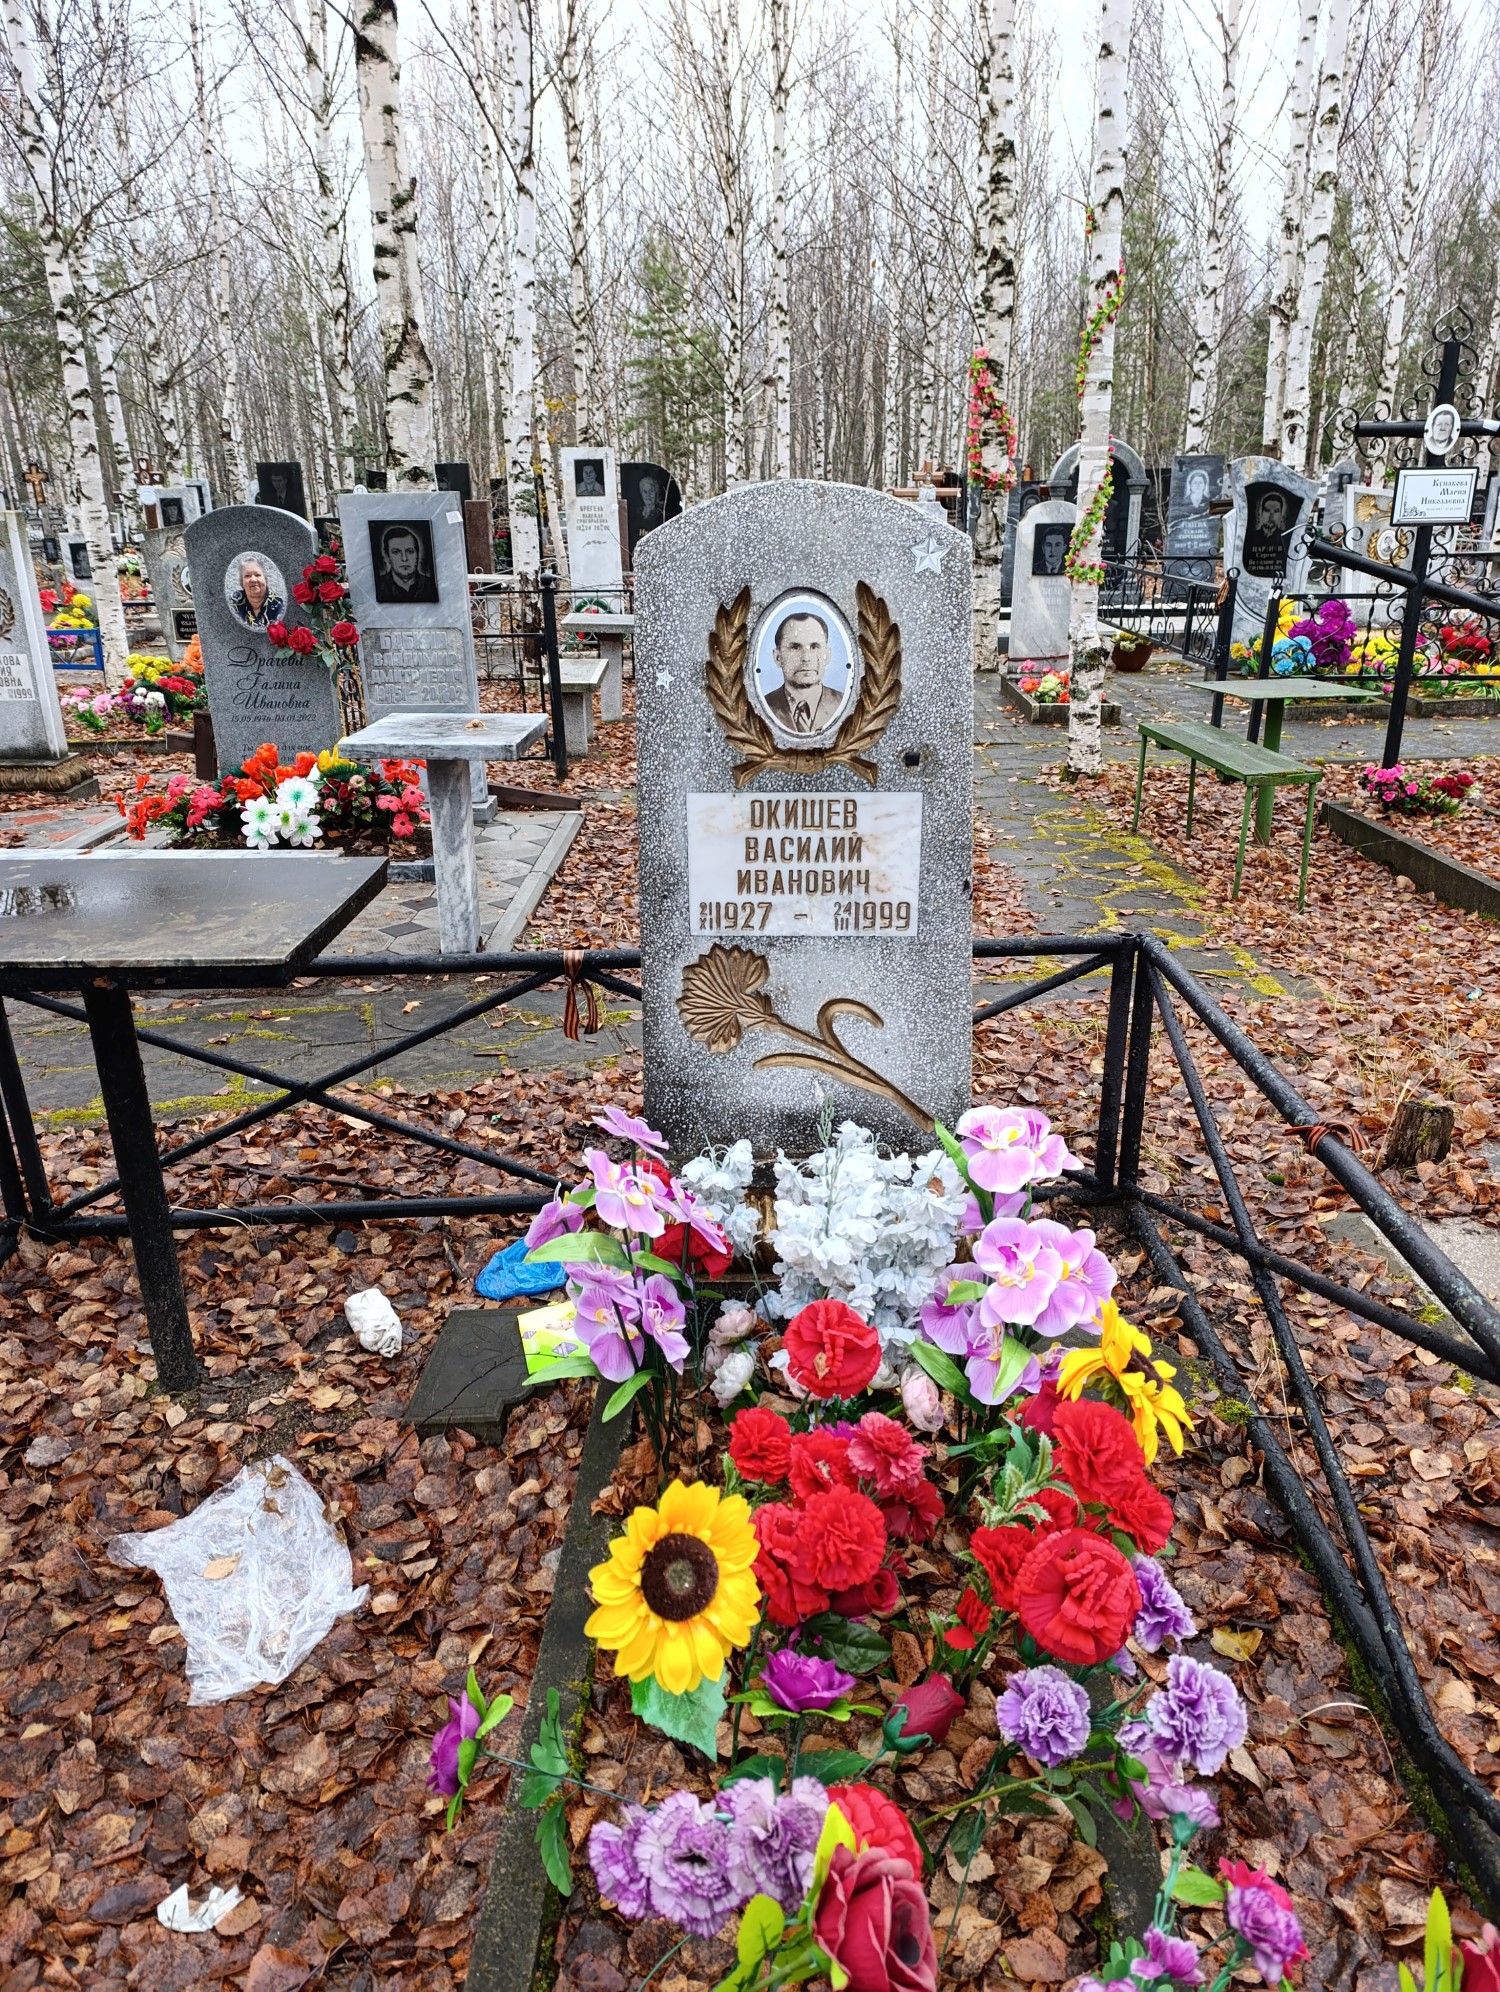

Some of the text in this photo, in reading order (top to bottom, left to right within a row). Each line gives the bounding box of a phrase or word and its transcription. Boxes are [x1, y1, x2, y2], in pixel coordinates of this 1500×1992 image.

[380, 631, 447, 650] БАБКИН
[373, 652, 460, 668] ВЛАДИМИР
[237, 673, 301, 690] Галина
[233, 692, 310, 709] Ивановна
[750, 798, 858, 831] ОКИШЕВ
[745, 832, 863, 864] ВАСИЛИЙ
[737, 869, 870, 896] ИВАНОВИЧ
[715, 901, 773, 931] 1927
[854, 901, 912, 932] 1999
